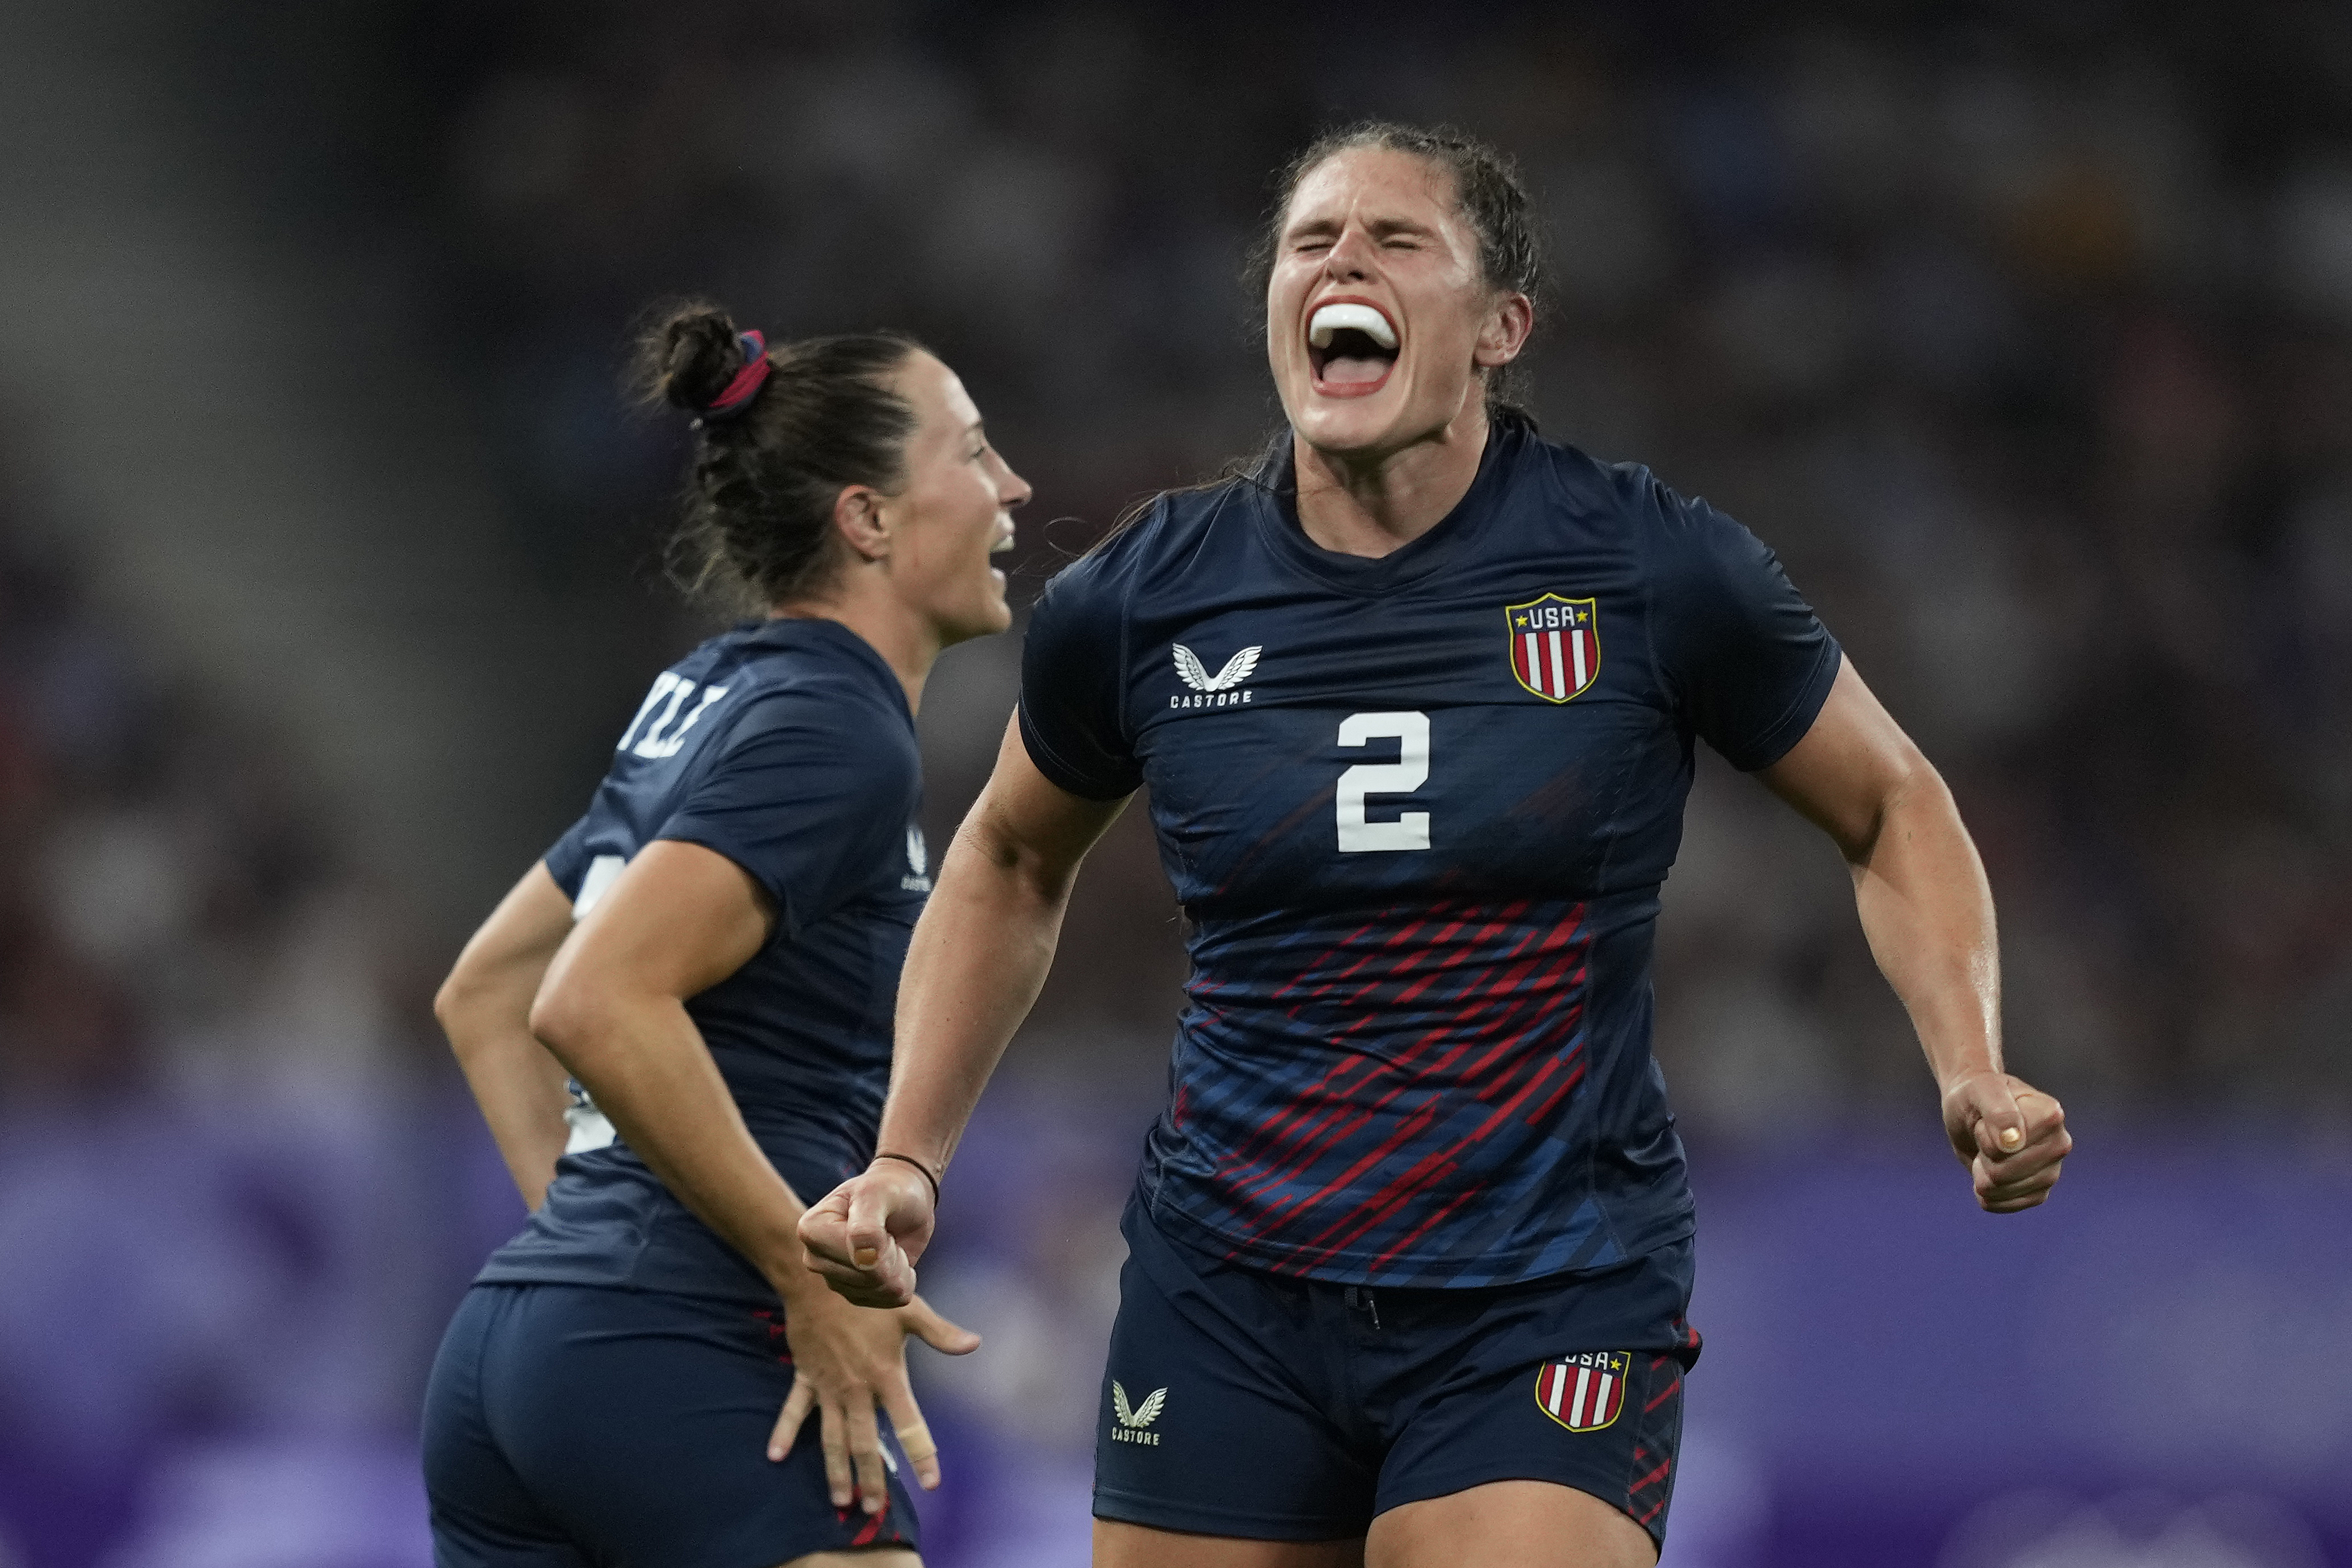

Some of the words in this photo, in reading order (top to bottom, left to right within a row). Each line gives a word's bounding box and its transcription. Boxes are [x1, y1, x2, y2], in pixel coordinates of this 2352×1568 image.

[1529, 606, 1575, 629] USA
[1170, 690, 1253, 709] CASTORE
[1336, 711, 1431, 853] 2
[1112, 1426, 1160, 1446] CASTORE
